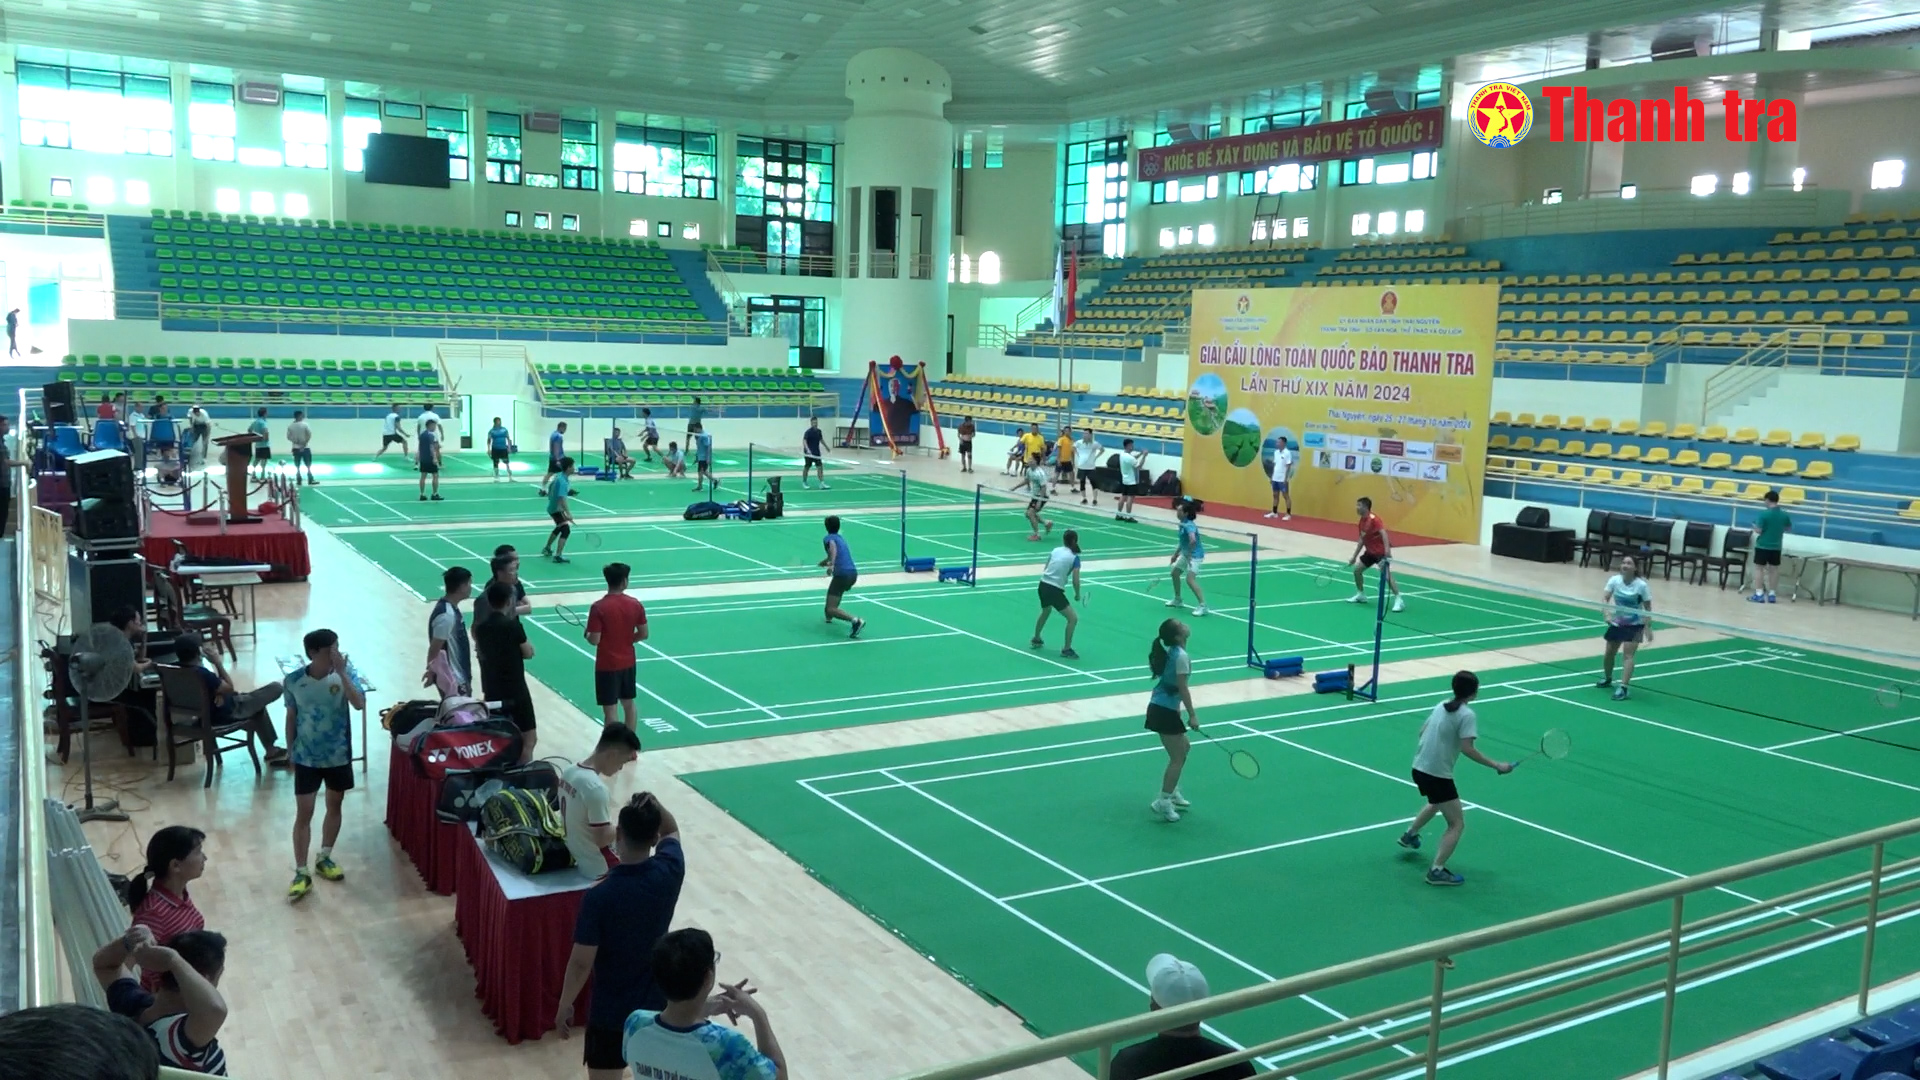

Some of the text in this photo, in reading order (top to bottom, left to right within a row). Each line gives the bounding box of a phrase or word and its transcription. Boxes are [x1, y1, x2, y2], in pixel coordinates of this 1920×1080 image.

[1163, 150, 1194, 173] KHỎE
[1215, 146, 1239, 166] XÂY
[1243, 141, 1279, 165] DỰNG
[1282, 137, 1300, 158] VÀ
[1303, 129, 1332, 155] BẢO
[1336, 129, 1353, 155] VỆ
[1357, 119, 1377, 148] TỔ
[1380, 114, 1422, 145] QUỐC
[1200, 339, 1475, 376] GIẢI CẦU LÔNG TOÀN QUỐC BÁO THANH TRA
[1241, 373, 1411, 402] LẦN THỨ XIX NĂM 2024
[1454, 420, 1471, 428] 2024
[454, 739, 495, 761] YONEX
